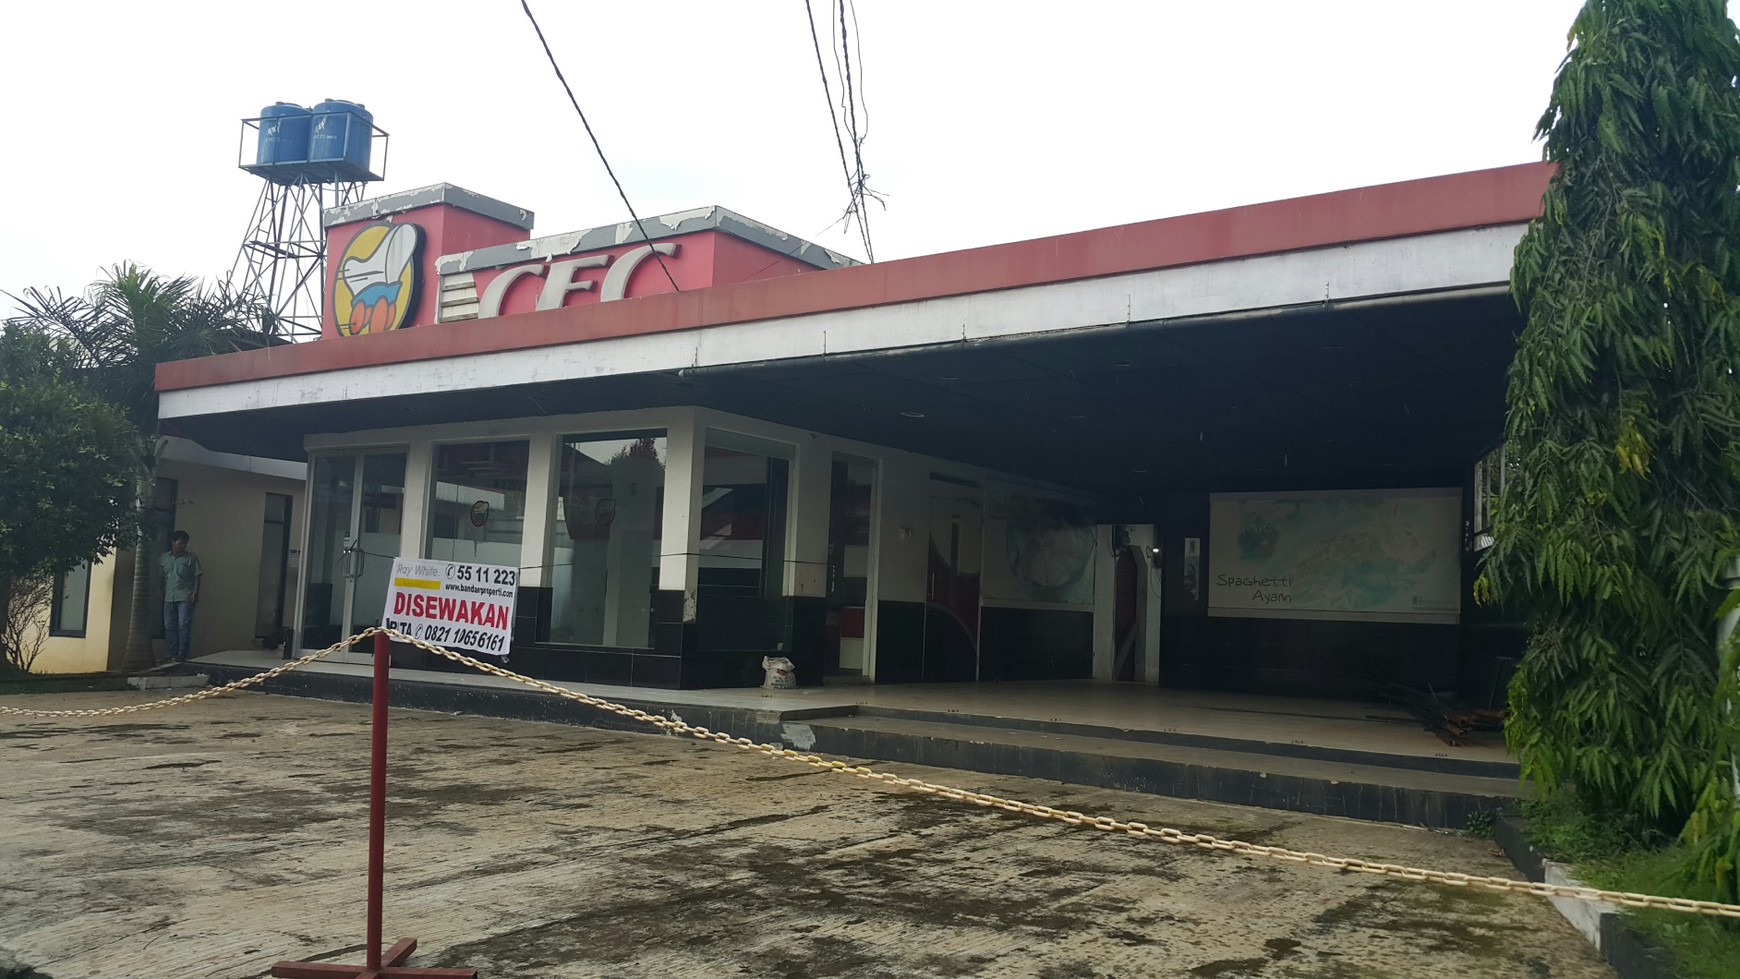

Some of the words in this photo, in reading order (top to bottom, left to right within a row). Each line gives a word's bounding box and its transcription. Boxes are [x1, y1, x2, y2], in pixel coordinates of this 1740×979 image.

[457, 565, 472, 581] 55
[476, 566, 489, 583] 11
[493, 569, 516, 586] 223
[393, 591, 510, 631] DISEWAKAN
[424, 624, 452, 642] 0821
